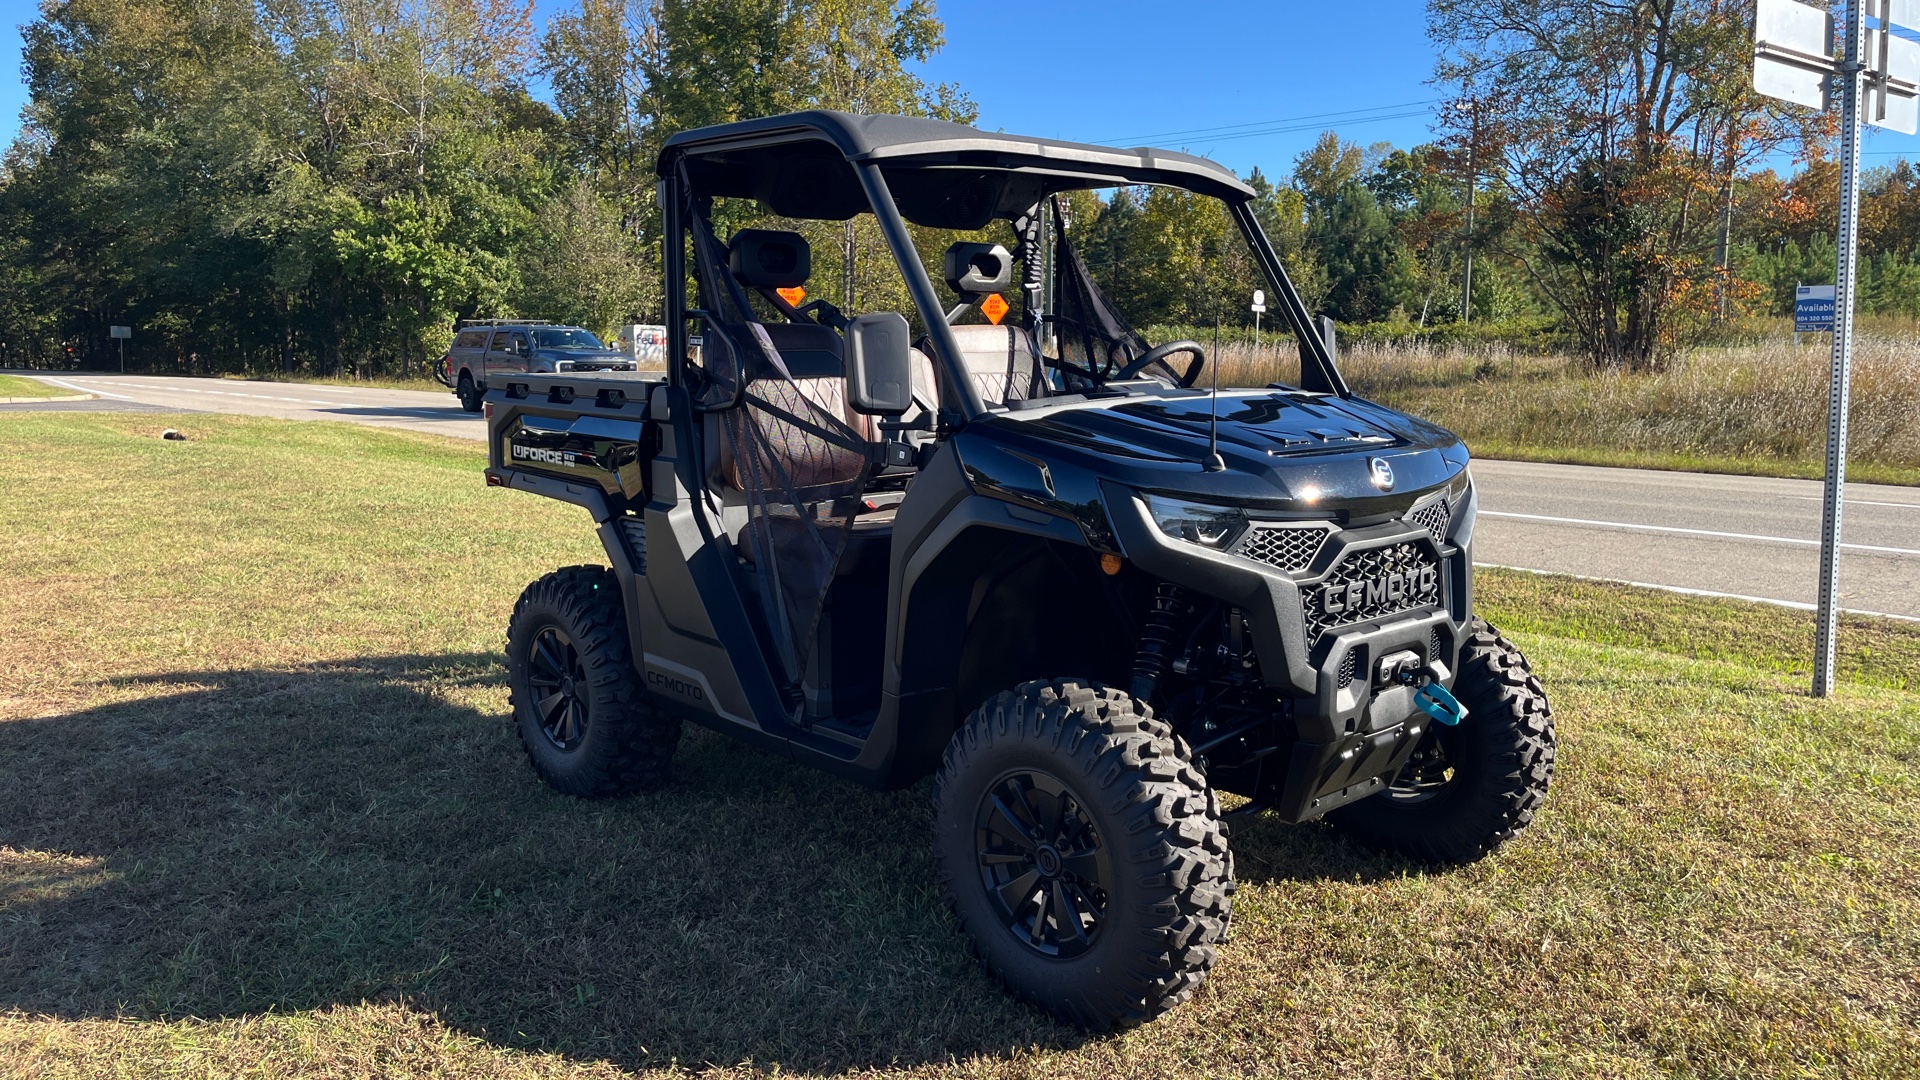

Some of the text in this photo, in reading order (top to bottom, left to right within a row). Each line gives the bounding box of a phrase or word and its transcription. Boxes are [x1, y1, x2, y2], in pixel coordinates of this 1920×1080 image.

[563, 460, 575, 468] PRO
[1323, 566, 1434, 614] CFMOTO
[647, 670, 703, 701] CFMOTO
